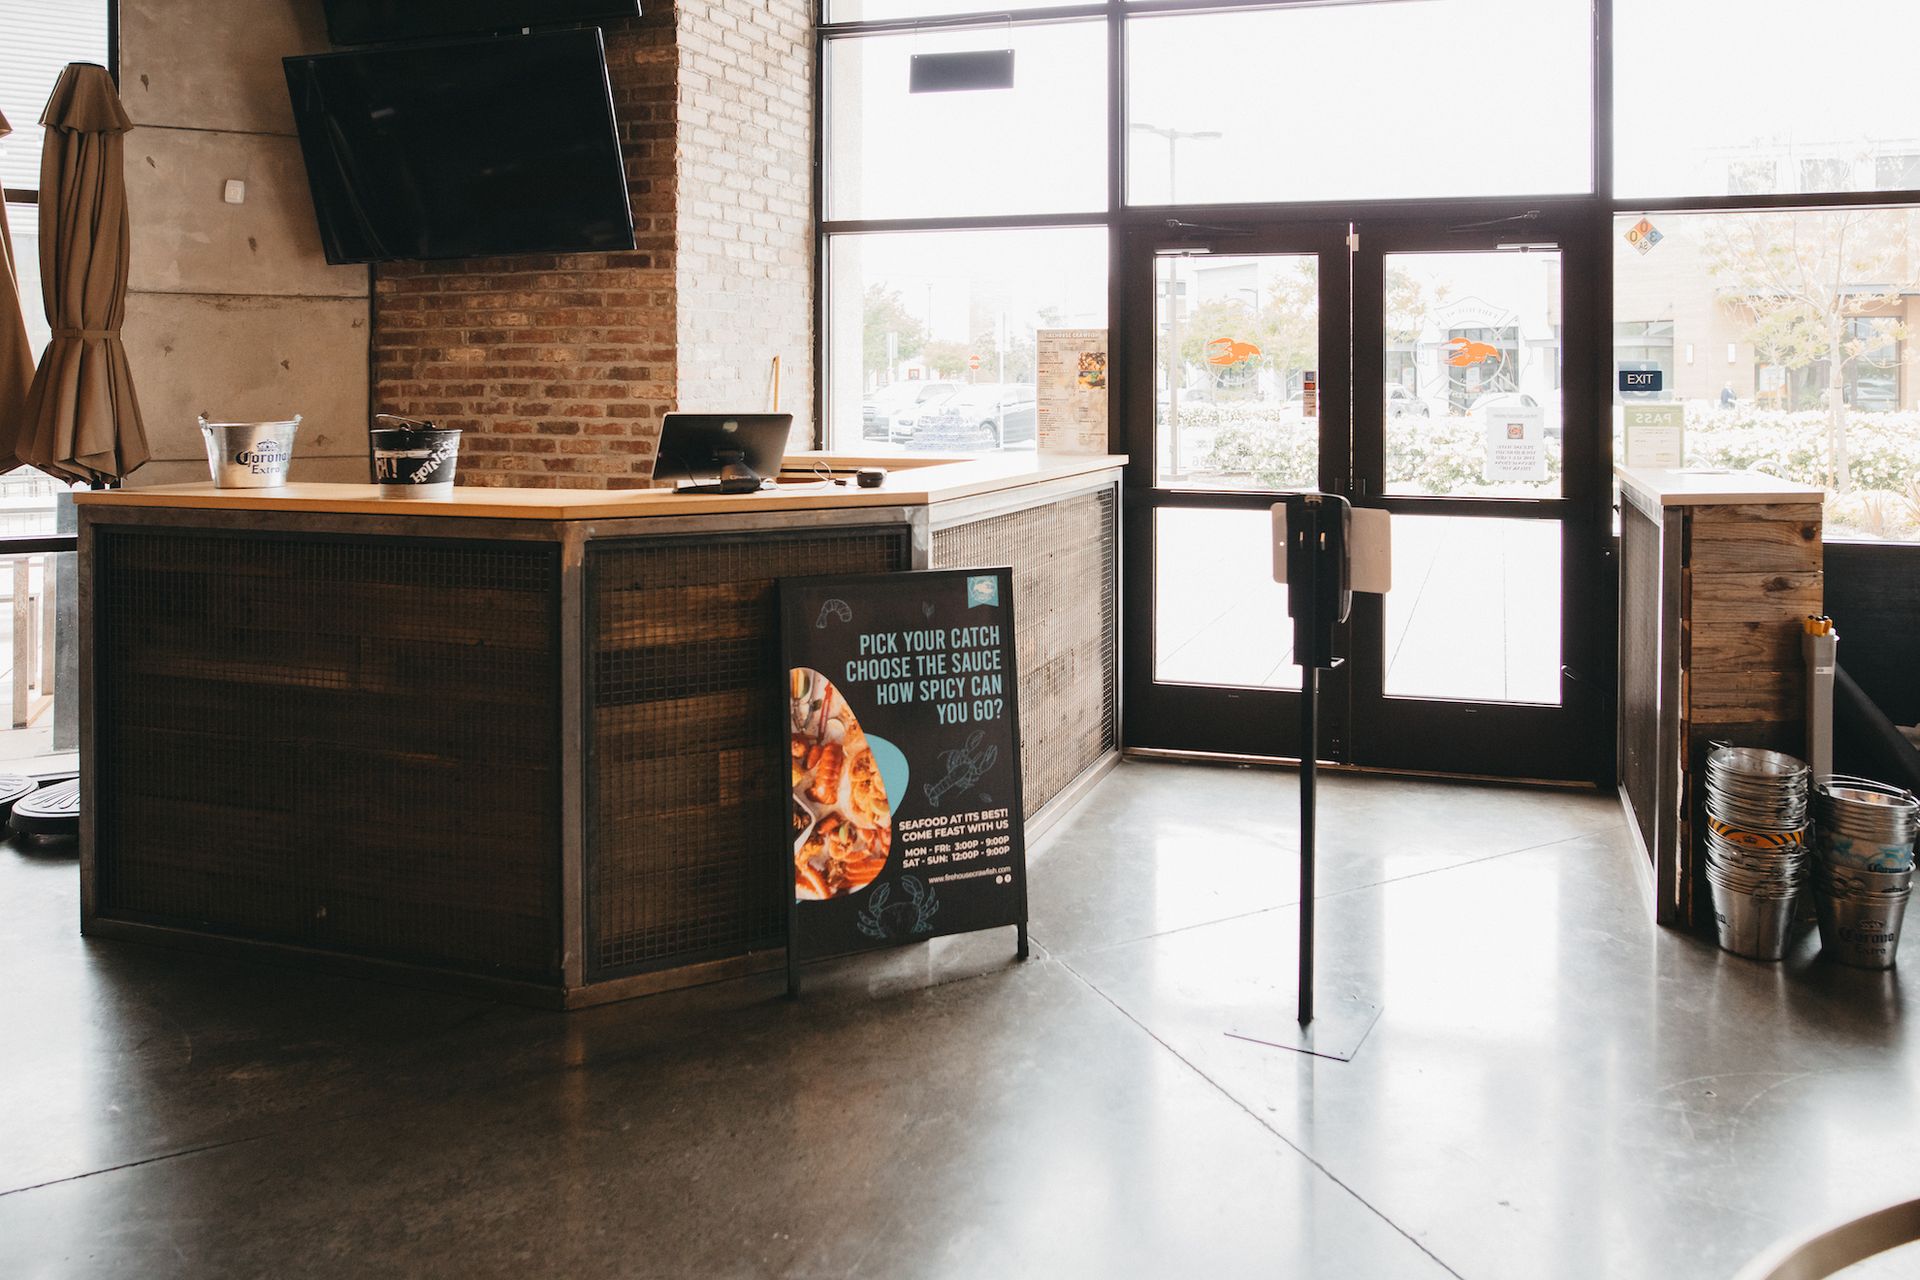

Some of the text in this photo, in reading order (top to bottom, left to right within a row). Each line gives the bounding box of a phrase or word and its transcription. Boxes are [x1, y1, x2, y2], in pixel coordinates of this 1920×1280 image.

[1627, 374, 1653, 384] EXIT
[235, 450, 288, 467] Corona
[252, 464, 280, 475] Extra
[860, 625, 1000, 655] PICK YOUR CATCH
[846, 650, 1001, 682] CHOOSE THE SAUCE
[877, 674, 1002, 705] HOW SPICY CAN
[937, 698, 1003, 724] YOU GO?
[899, 808, 1008, 831] SEAFOOD AT ITS BEST!
[902, 819, 1009, 842] COME FEAST WITH US
[902, 858, 920, 868] SAT
[927, 854, 949, 865] SUN:
[952, 850, 979, 861] 12:00P
[985, 845, 1010, 857] 9:00P
[904, 846, 927, 858] MON
[934, 843, 951, 854] FRI:
[954, 839, 979, 851] 3:00P
[985, 835, 1010, 847] 9:00P
[928, 866, 1012, 884] www.firehousecrawfish.com
